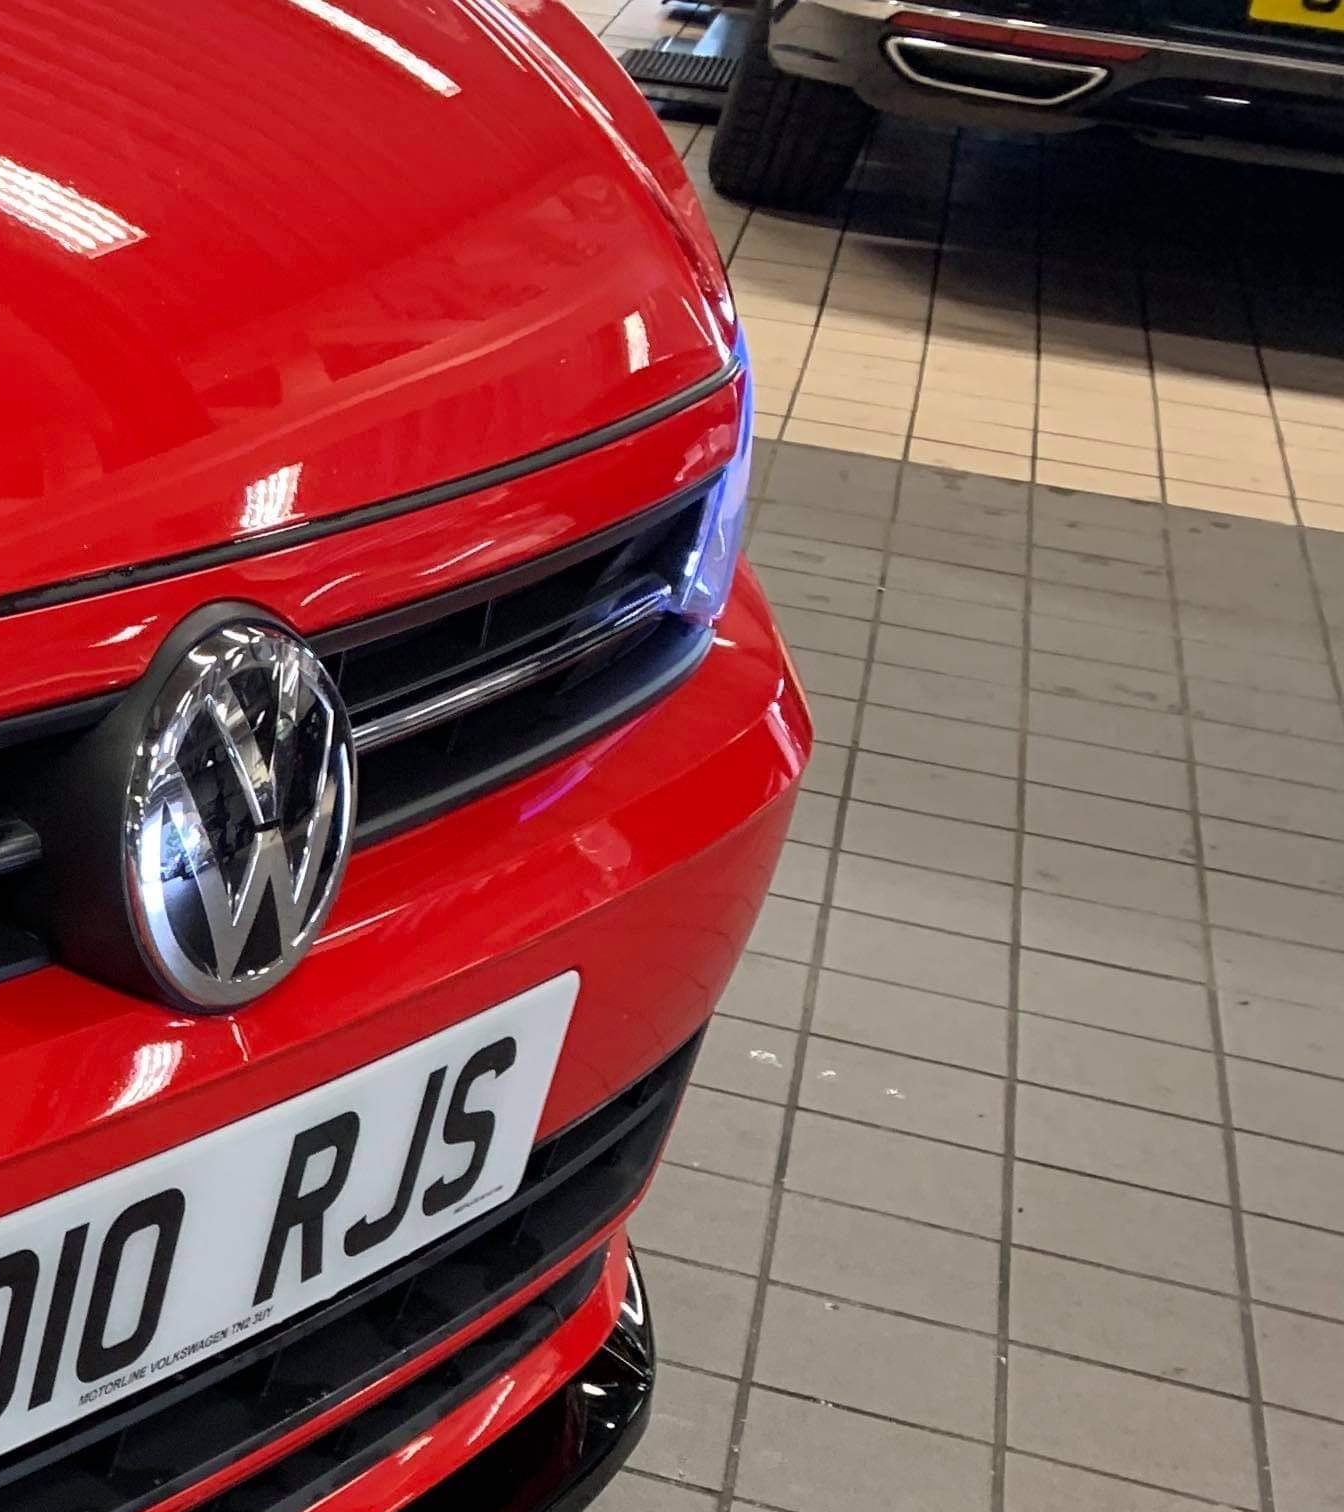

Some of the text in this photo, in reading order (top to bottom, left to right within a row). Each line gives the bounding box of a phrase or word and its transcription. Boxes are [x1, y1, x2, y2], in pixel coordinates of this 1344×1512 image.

[128, 622, 354, 1006] VW
[253, 1037, 516, 1306] RJS
[78, 1366, 147, 1405] MOTORLINE
[150, 1327, 228, 1373] VOLKSWAGEN
